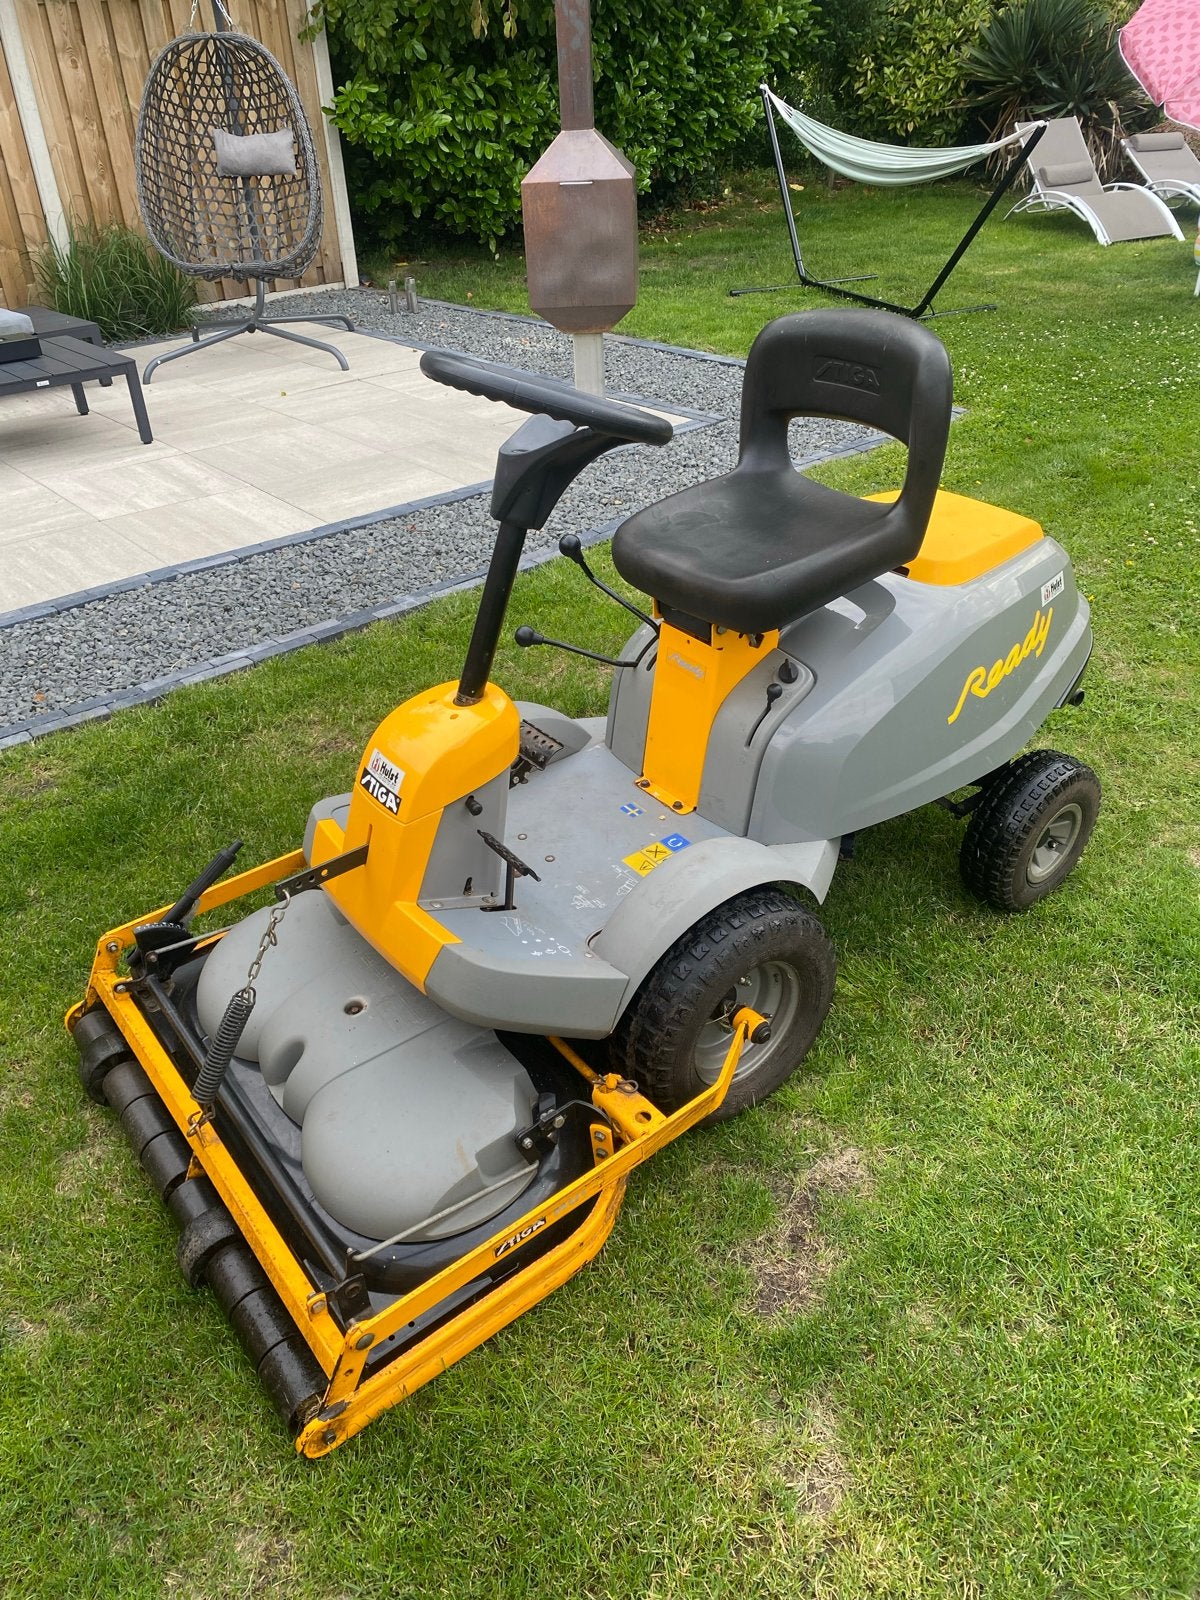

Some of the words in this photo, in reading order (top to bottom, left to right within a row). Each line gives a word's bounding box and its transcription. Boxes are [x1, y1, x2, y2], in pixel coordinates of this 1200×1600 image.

[946, 606, 1054, 725] Ready
[380, 761, 399, 784] Hulst
[360, 774, 398, 814] STIGA
[496, 1218, 546, 1257] STIGA
